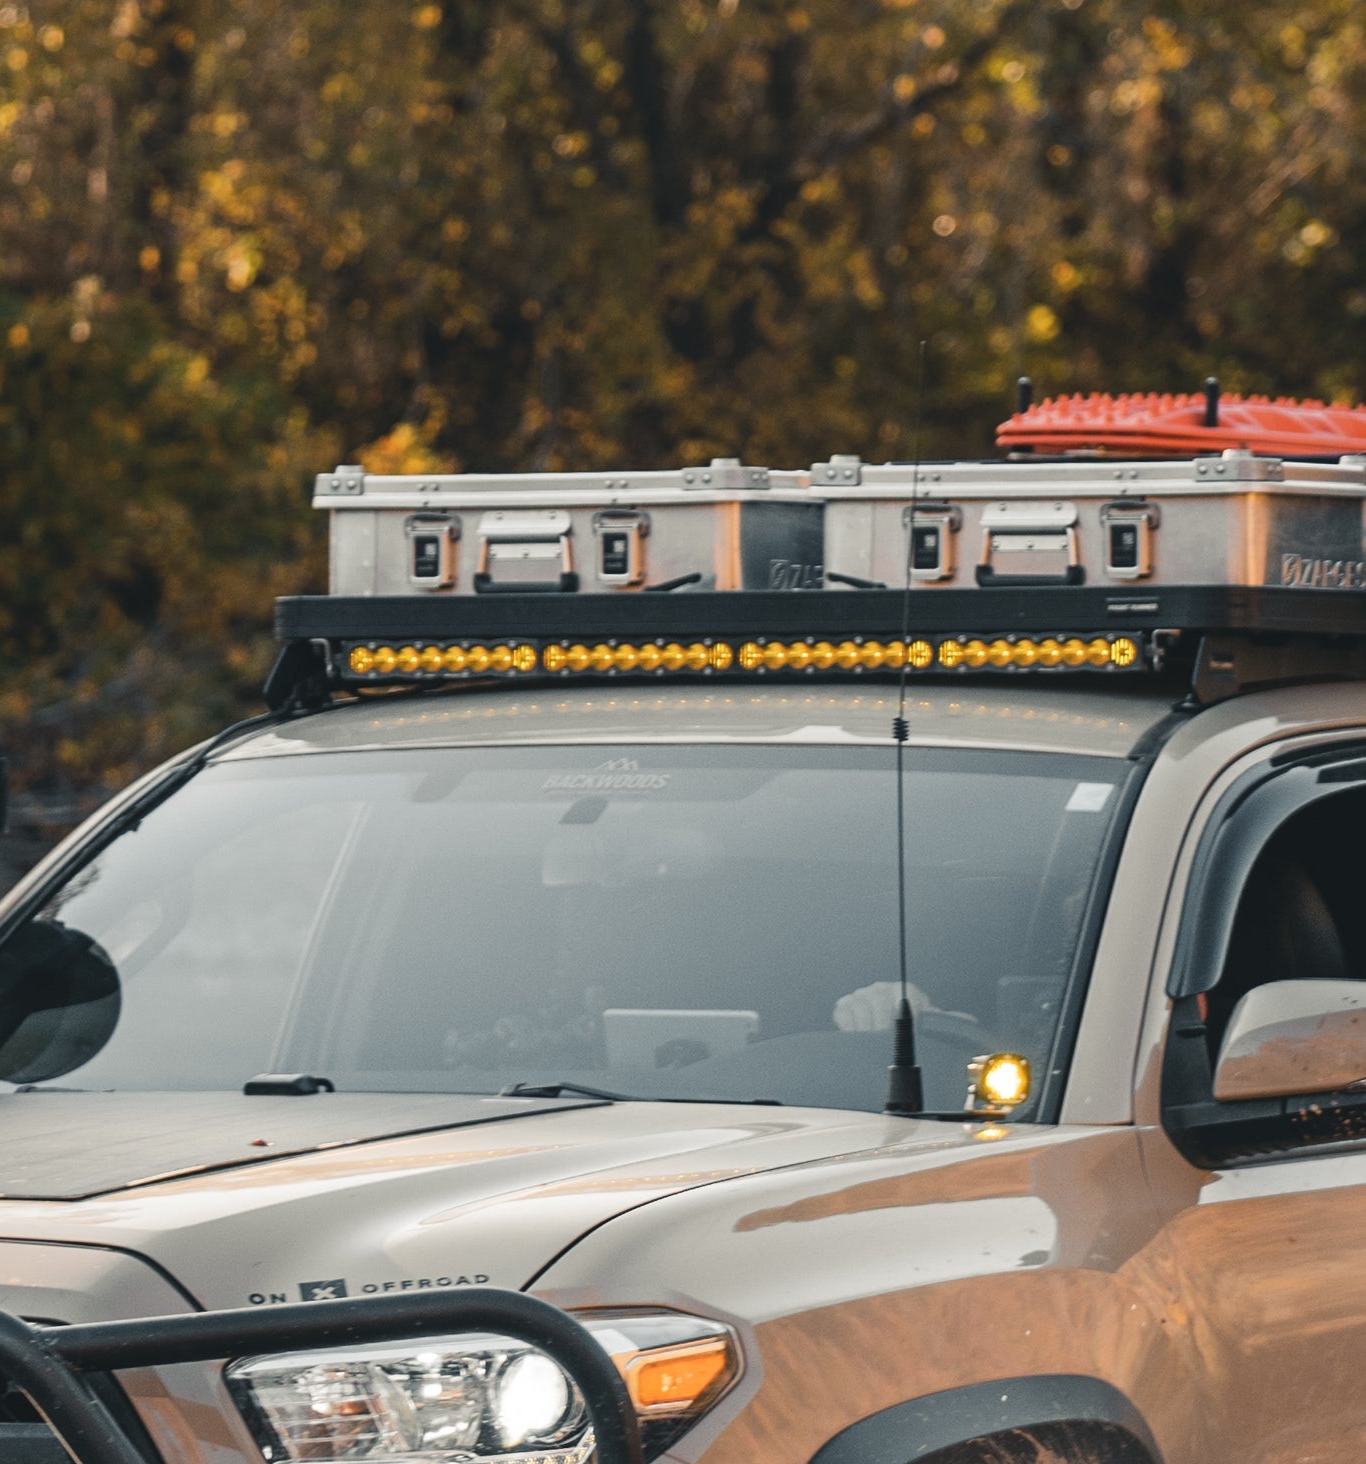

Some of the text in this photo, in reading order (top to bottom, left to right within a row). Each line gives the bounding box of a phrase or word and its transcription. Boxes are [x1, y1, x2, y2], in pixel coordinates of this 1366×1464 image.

[541, 774, 671, 790] BACKWOODS
[248, 1292, 287, 1305] ON
[362, 1274, 490, 1293] OFFROAD
